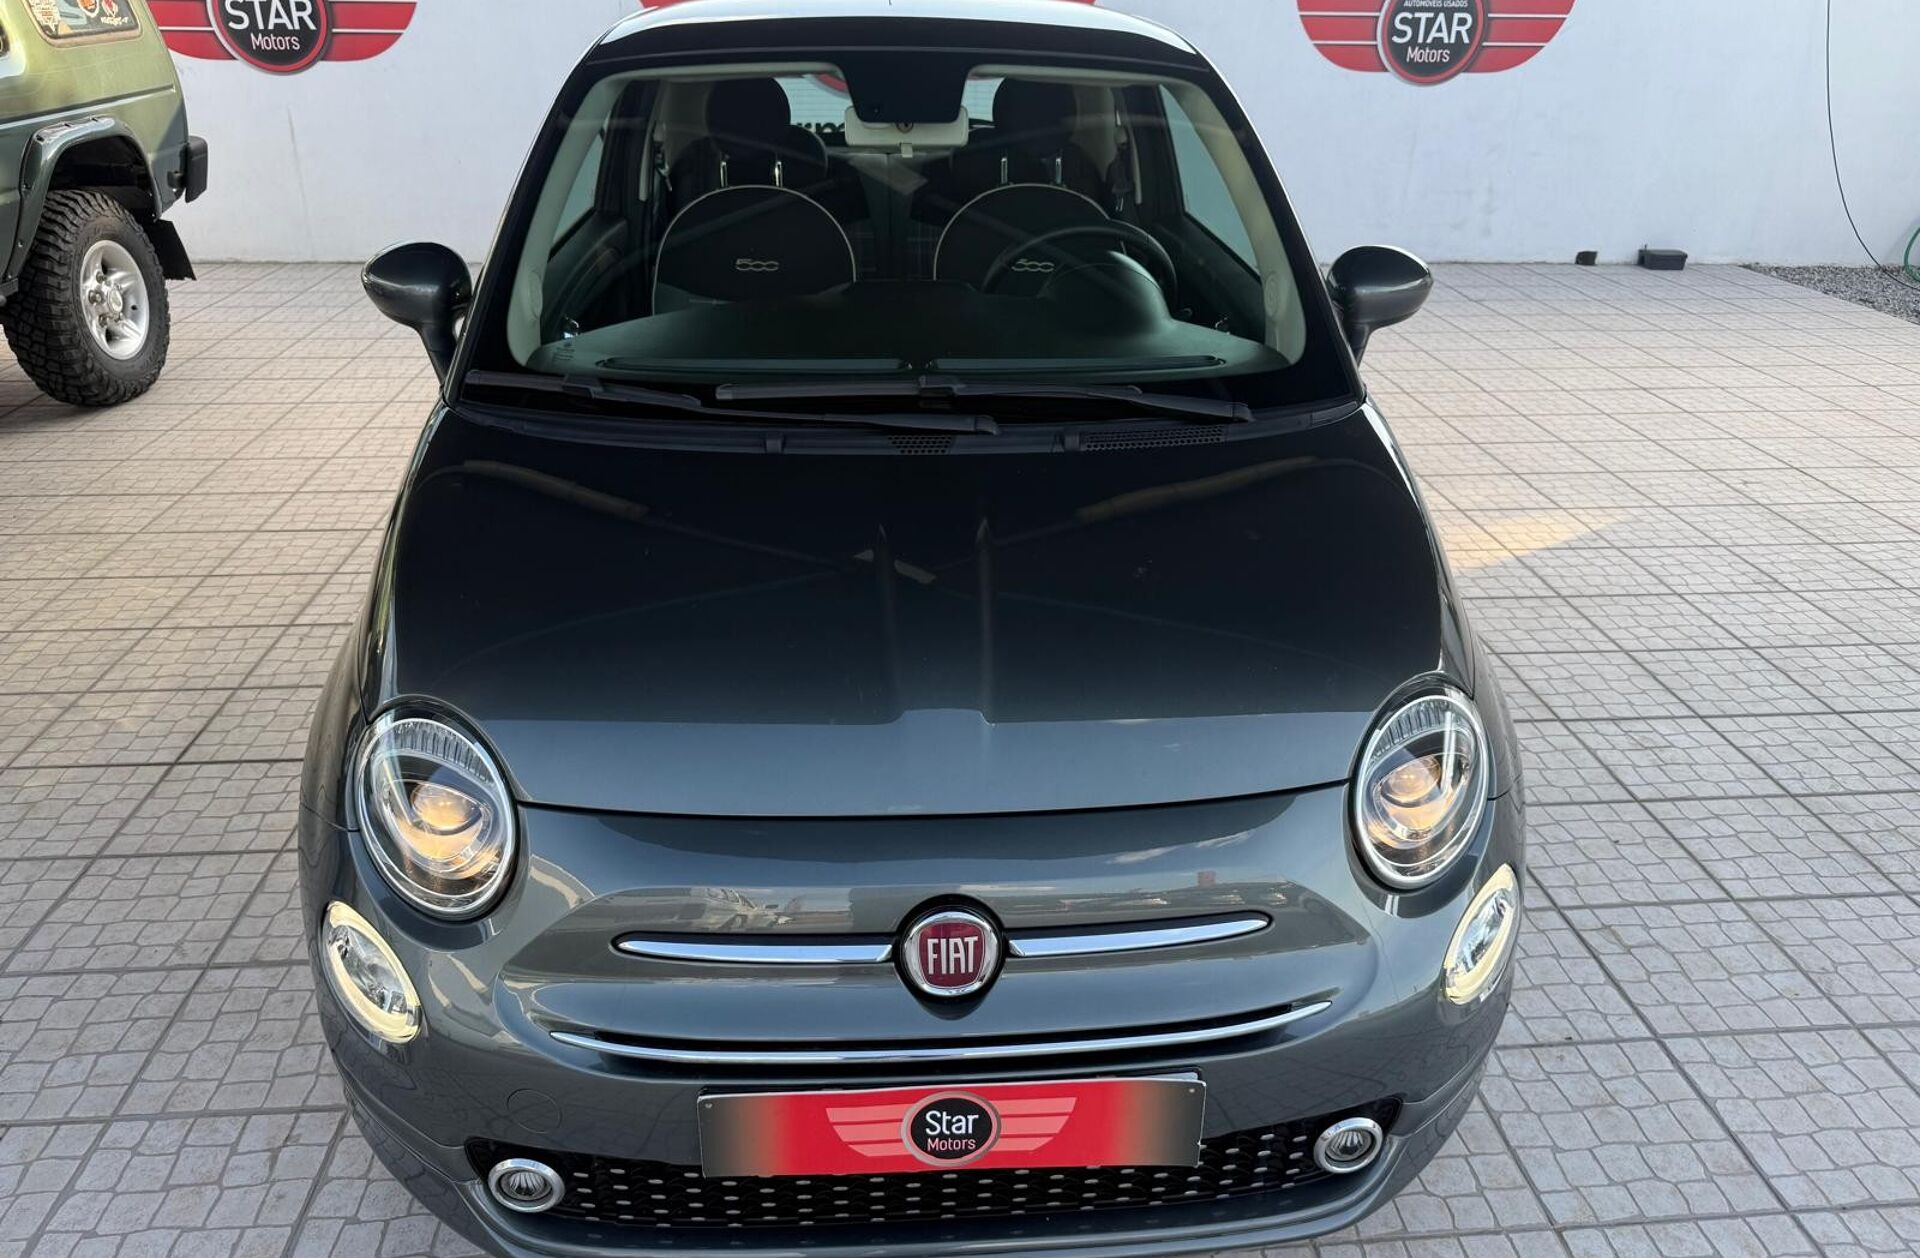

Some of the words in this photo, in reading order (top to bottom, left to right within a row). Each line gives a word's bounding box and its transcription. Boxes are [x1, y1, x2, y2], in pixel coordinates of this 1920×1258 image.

[225, 0, 317, 30] STAR
[1391, 12, 1472, 44] STAR
[250, 33, 301, 51] Motors
[1406, 46, 1451, 63] Motors
[736, 258, 779, 272] 500
[927, 936, 979, 975] FIAT
[925, 1110, 980, 1136] Star
[927, 1137, 977, 1152] Motors
